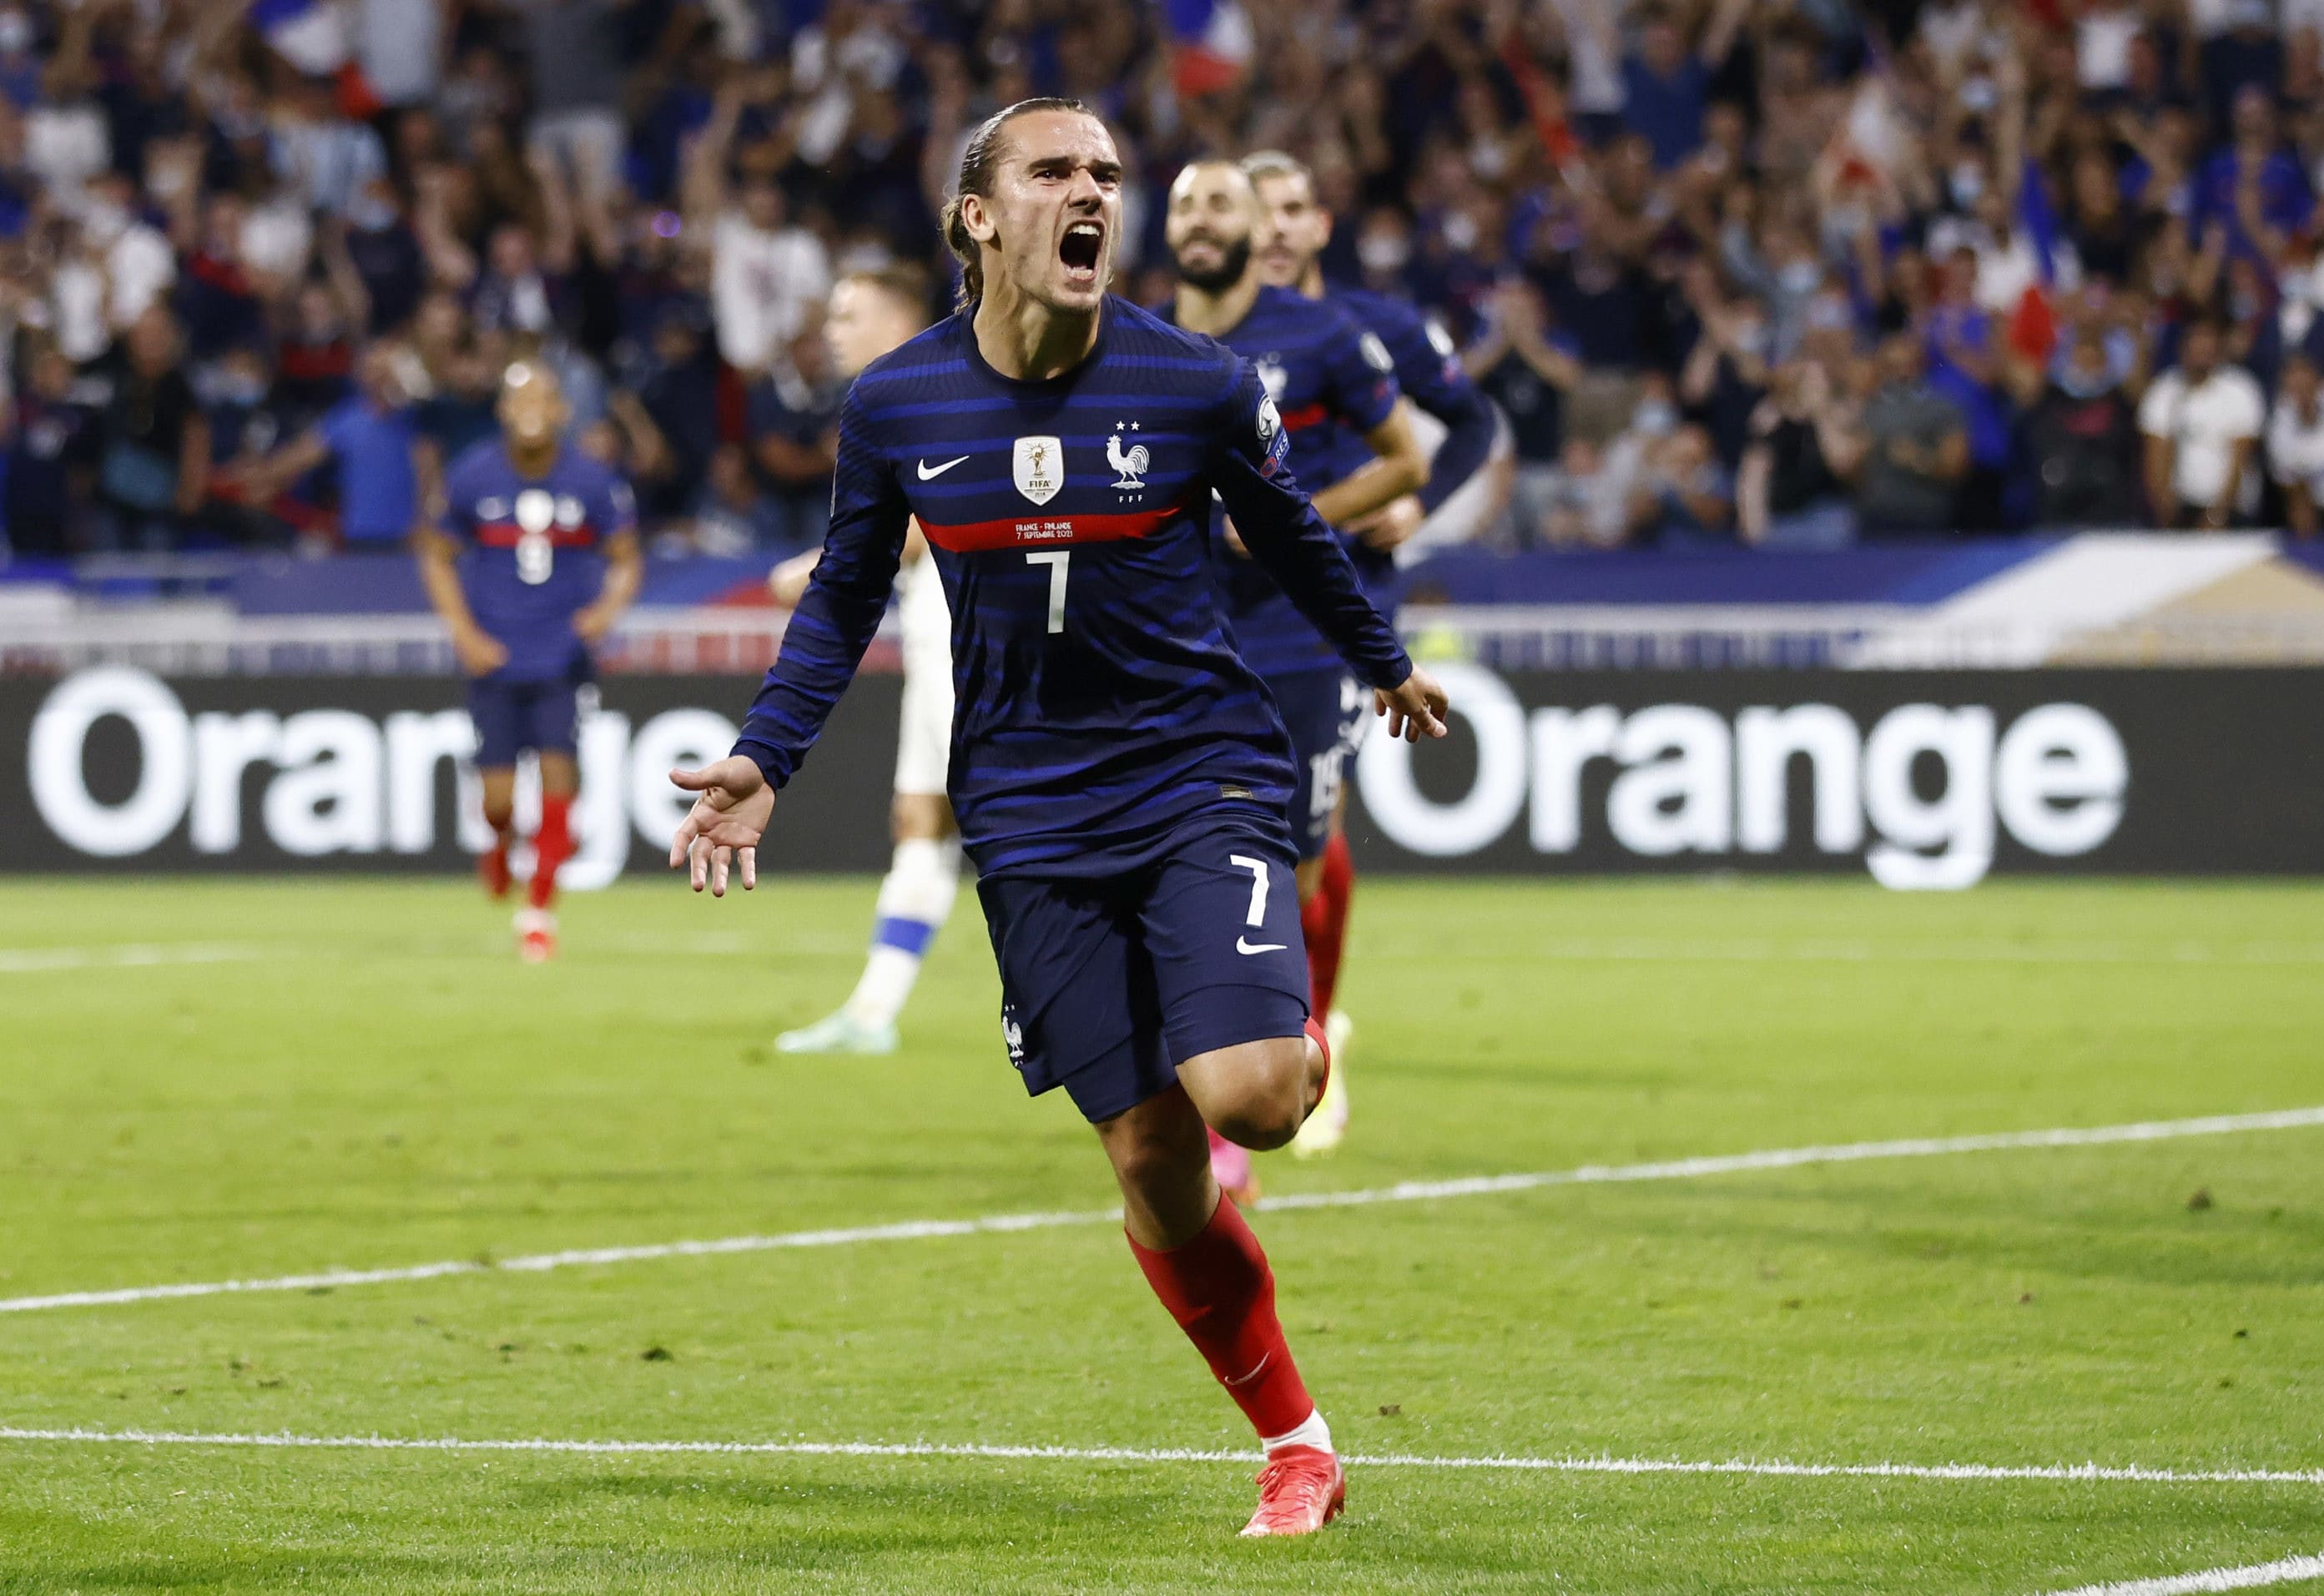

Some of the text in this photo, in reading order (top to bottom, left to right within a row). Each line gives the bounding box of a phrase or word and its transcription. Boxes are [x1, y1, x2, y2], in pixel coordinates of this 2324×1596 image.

[1029, 480, 1051, 488] FIFA
[1016, 523, 1038, 531] FRANCE
[1044, 521, 1071, 530] FINLANDE
[1023, 531, 1056, 539] SEPTEMBRE
[1056, 530, 1073, 538] 2021
[1026, 551, 1070, 633] 7
[1357, 664, 2130, 890] Orange
[1229, 854, 1269, 926] 7
